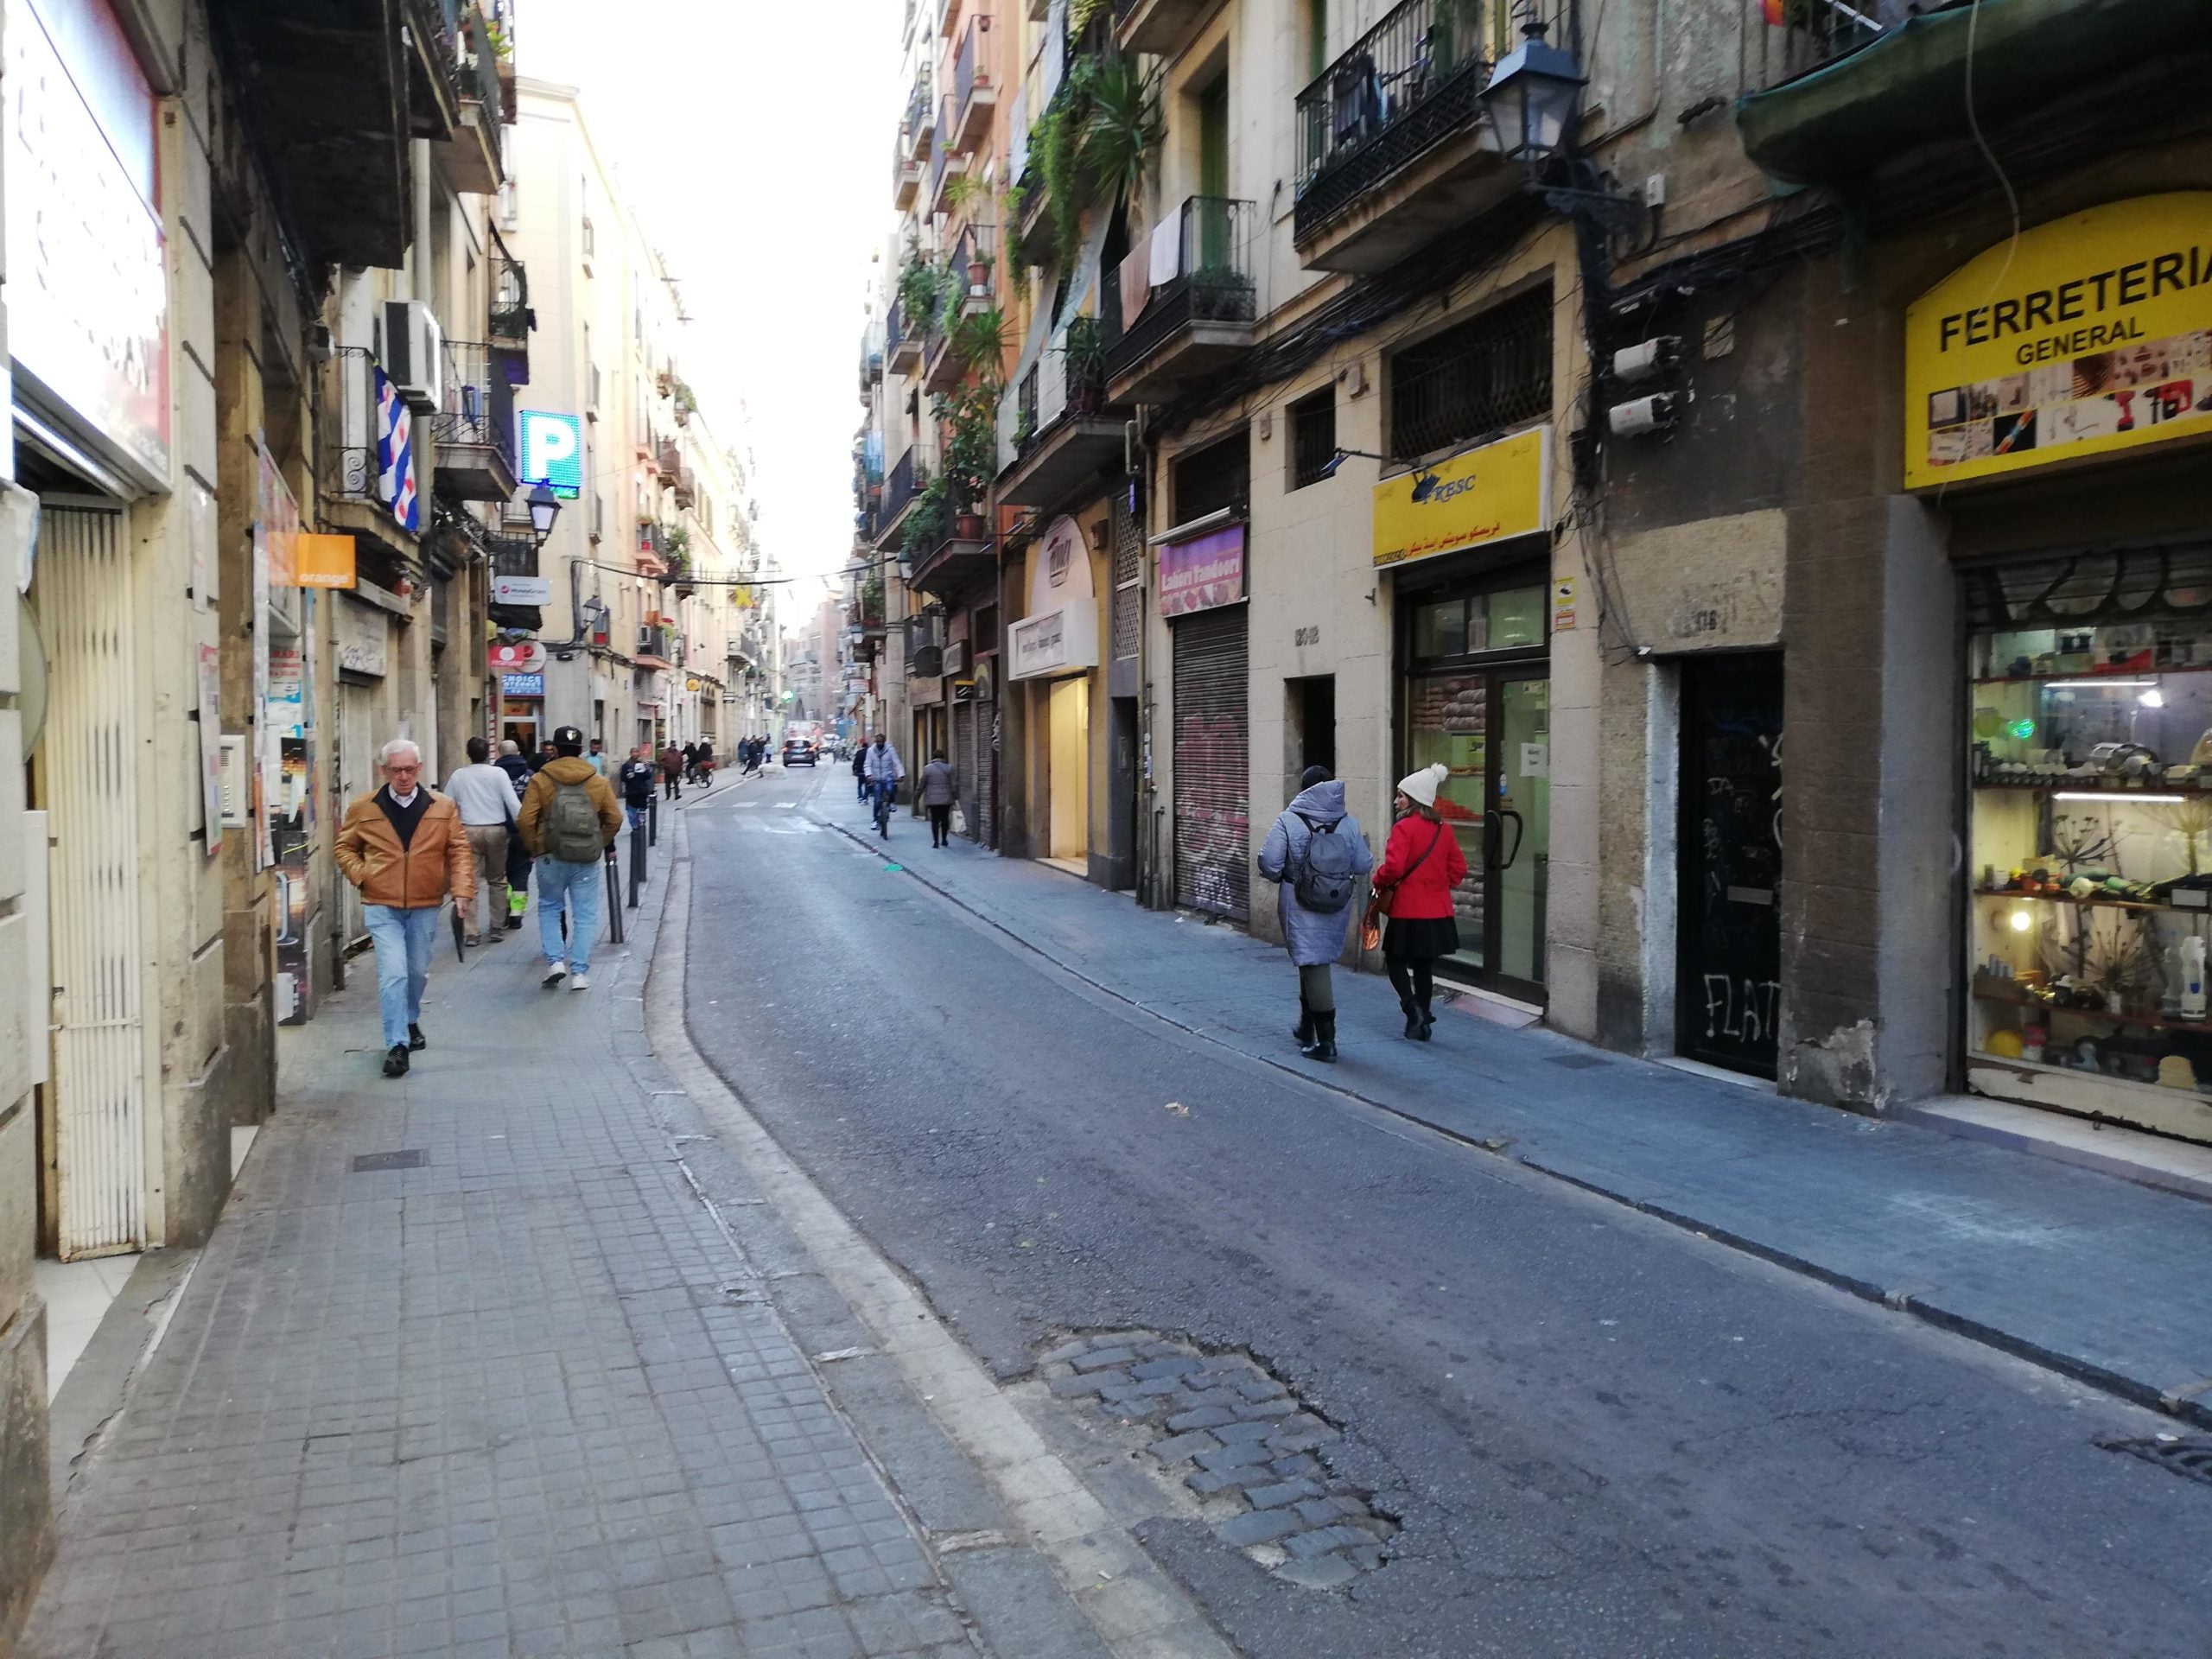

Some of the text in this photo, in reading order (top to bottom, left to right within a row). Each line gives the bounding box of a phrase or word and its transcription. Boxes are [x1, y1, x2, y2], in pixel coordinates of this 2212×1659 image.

[2017, 316, 2145, 365] GENERAL
[528, 416, 575, 480] P
[300, 574, 349, 586] orange
